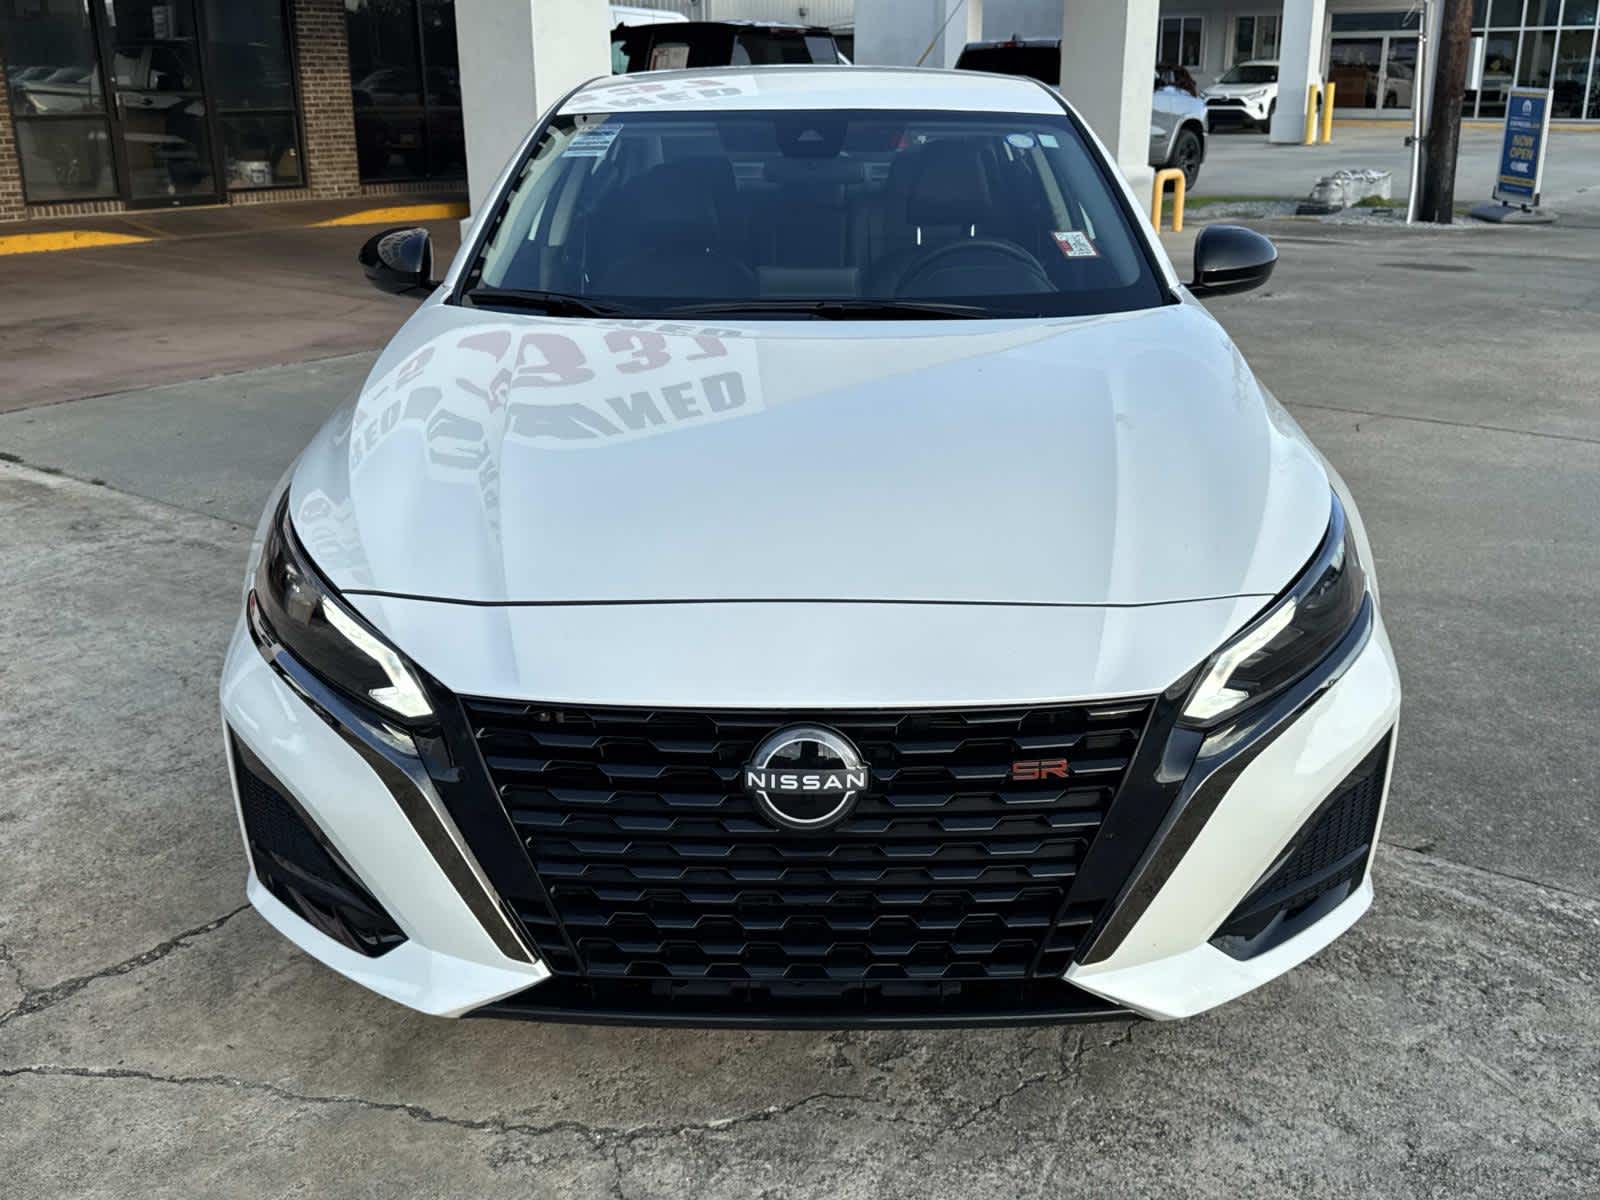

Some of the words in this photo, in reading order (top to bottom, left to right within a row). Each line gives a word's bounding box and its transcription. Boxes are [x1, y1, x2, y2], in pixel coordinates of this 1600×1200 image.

[1513, 134, 1536, 147] NOW
[1509, 146, 1535, 161] OPEN
[1012, 758, 1069, 781] SR
[747, 771, 866, 790] NISSAN
